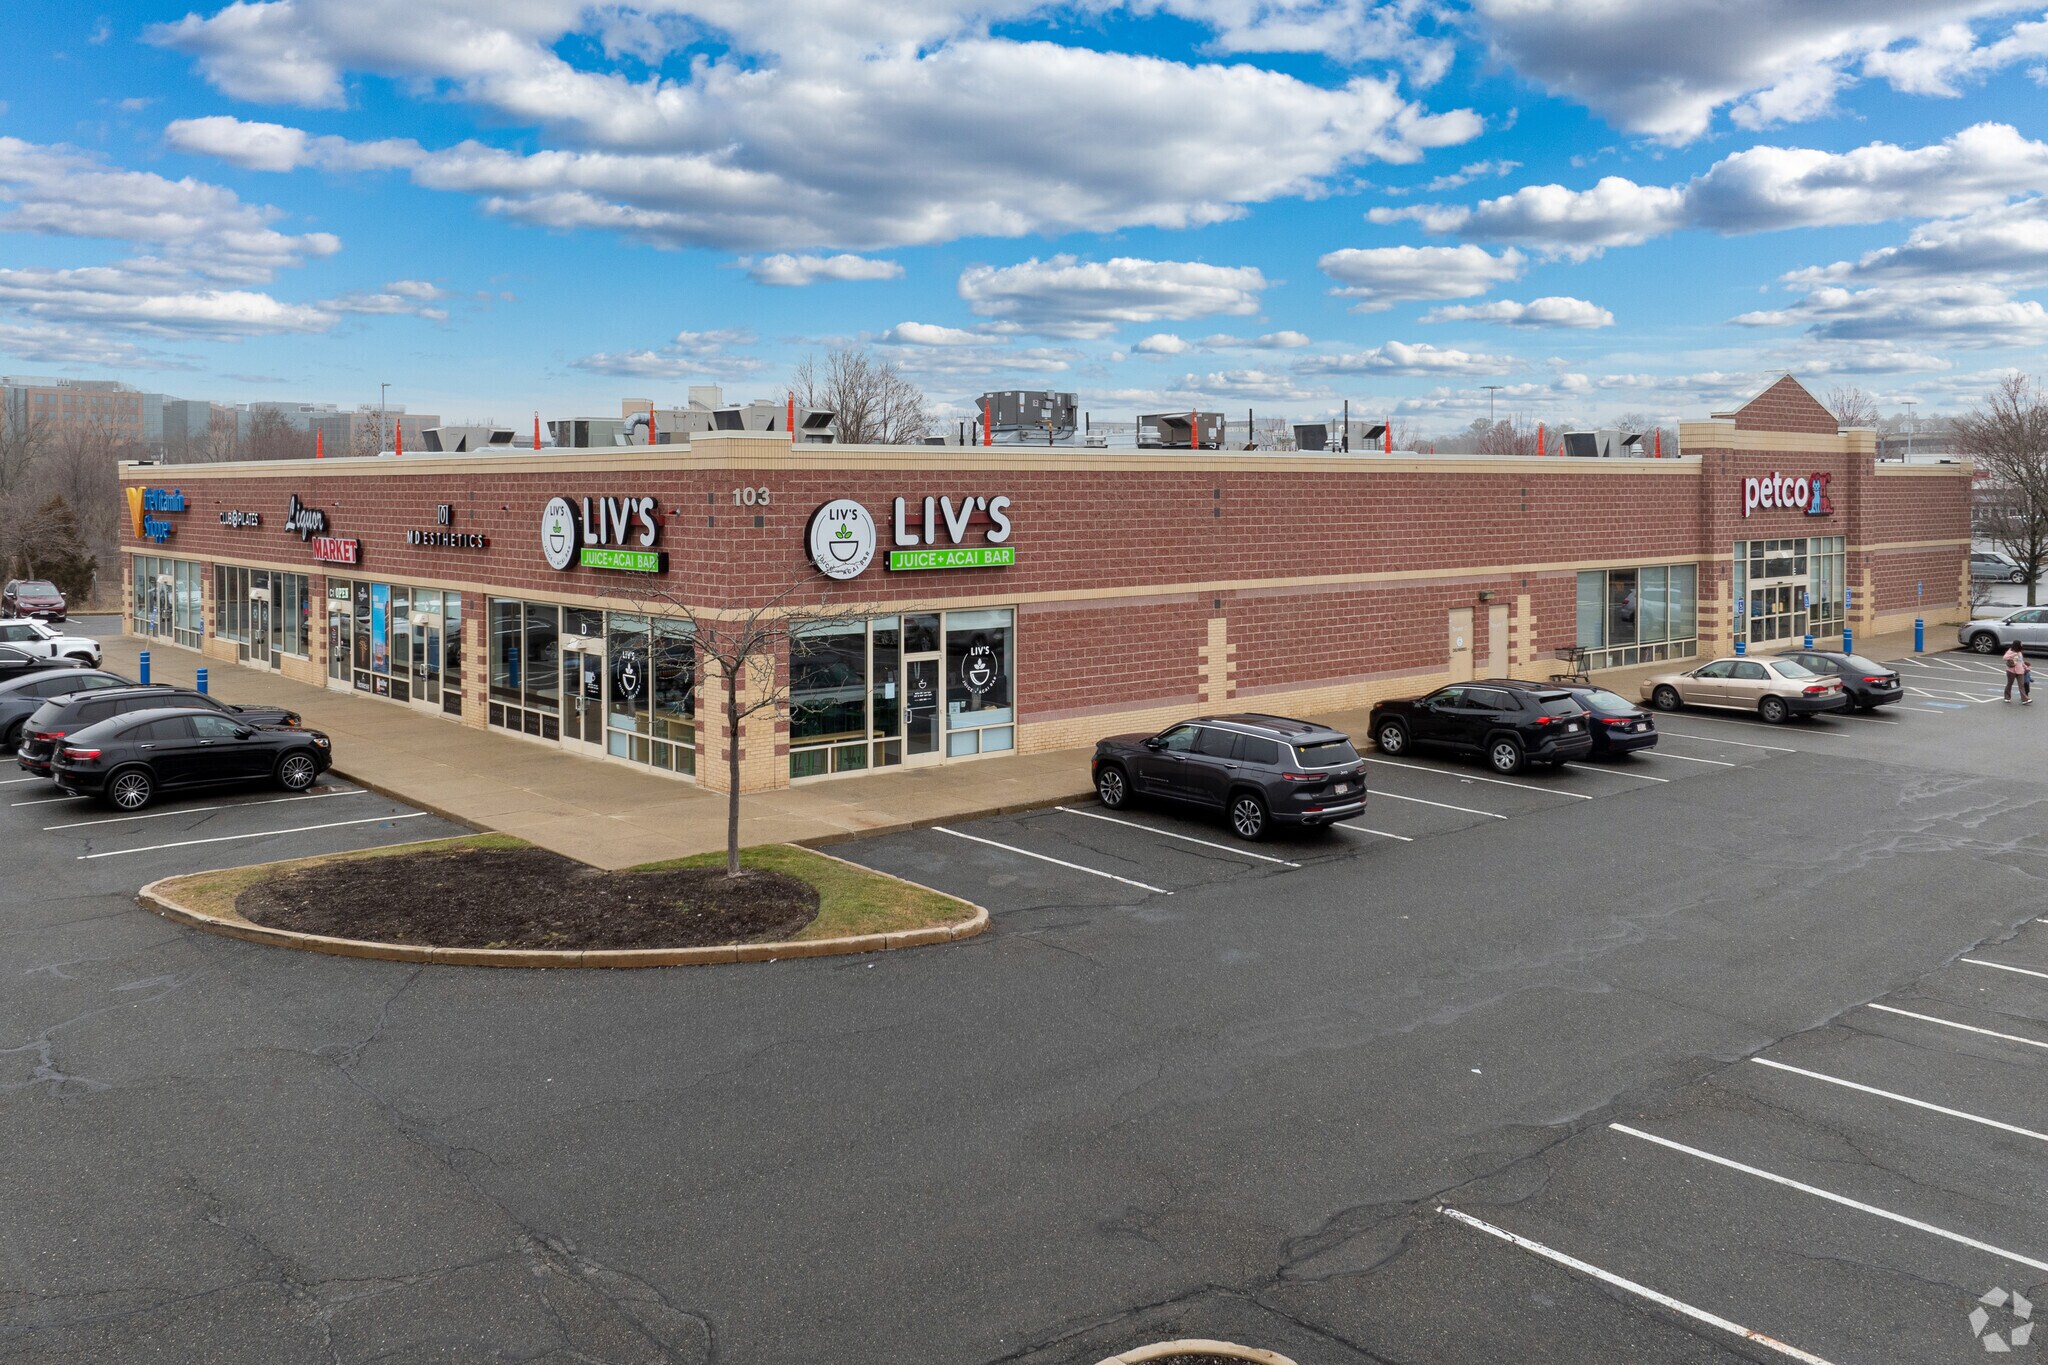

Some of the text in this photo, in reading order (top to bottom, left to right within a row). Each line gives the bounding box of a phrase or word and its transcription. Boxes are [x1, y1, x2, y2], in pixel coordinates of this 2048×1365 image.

[732, 487, 770, 506] 103
[1745, 471, 1808, 518] petco
[284, 495, 324, 540] Liquor
[549, 506, 564, 516] LIV'S
[829, 508, 858, 520] LIV'S
[219, 512, 259, 526] CLUB PILATES
[584, 496, 655, 546] LIV'S
[895, 496, 1011, 546] LIV'S
[312, 537, 357, 563] MARKET
[984, 550, 1010, 564] BAR
[637, 555, 655, 569] BAR
[581, 623, 587, 635] D
[970, 646, 990, 656] LIV'S
